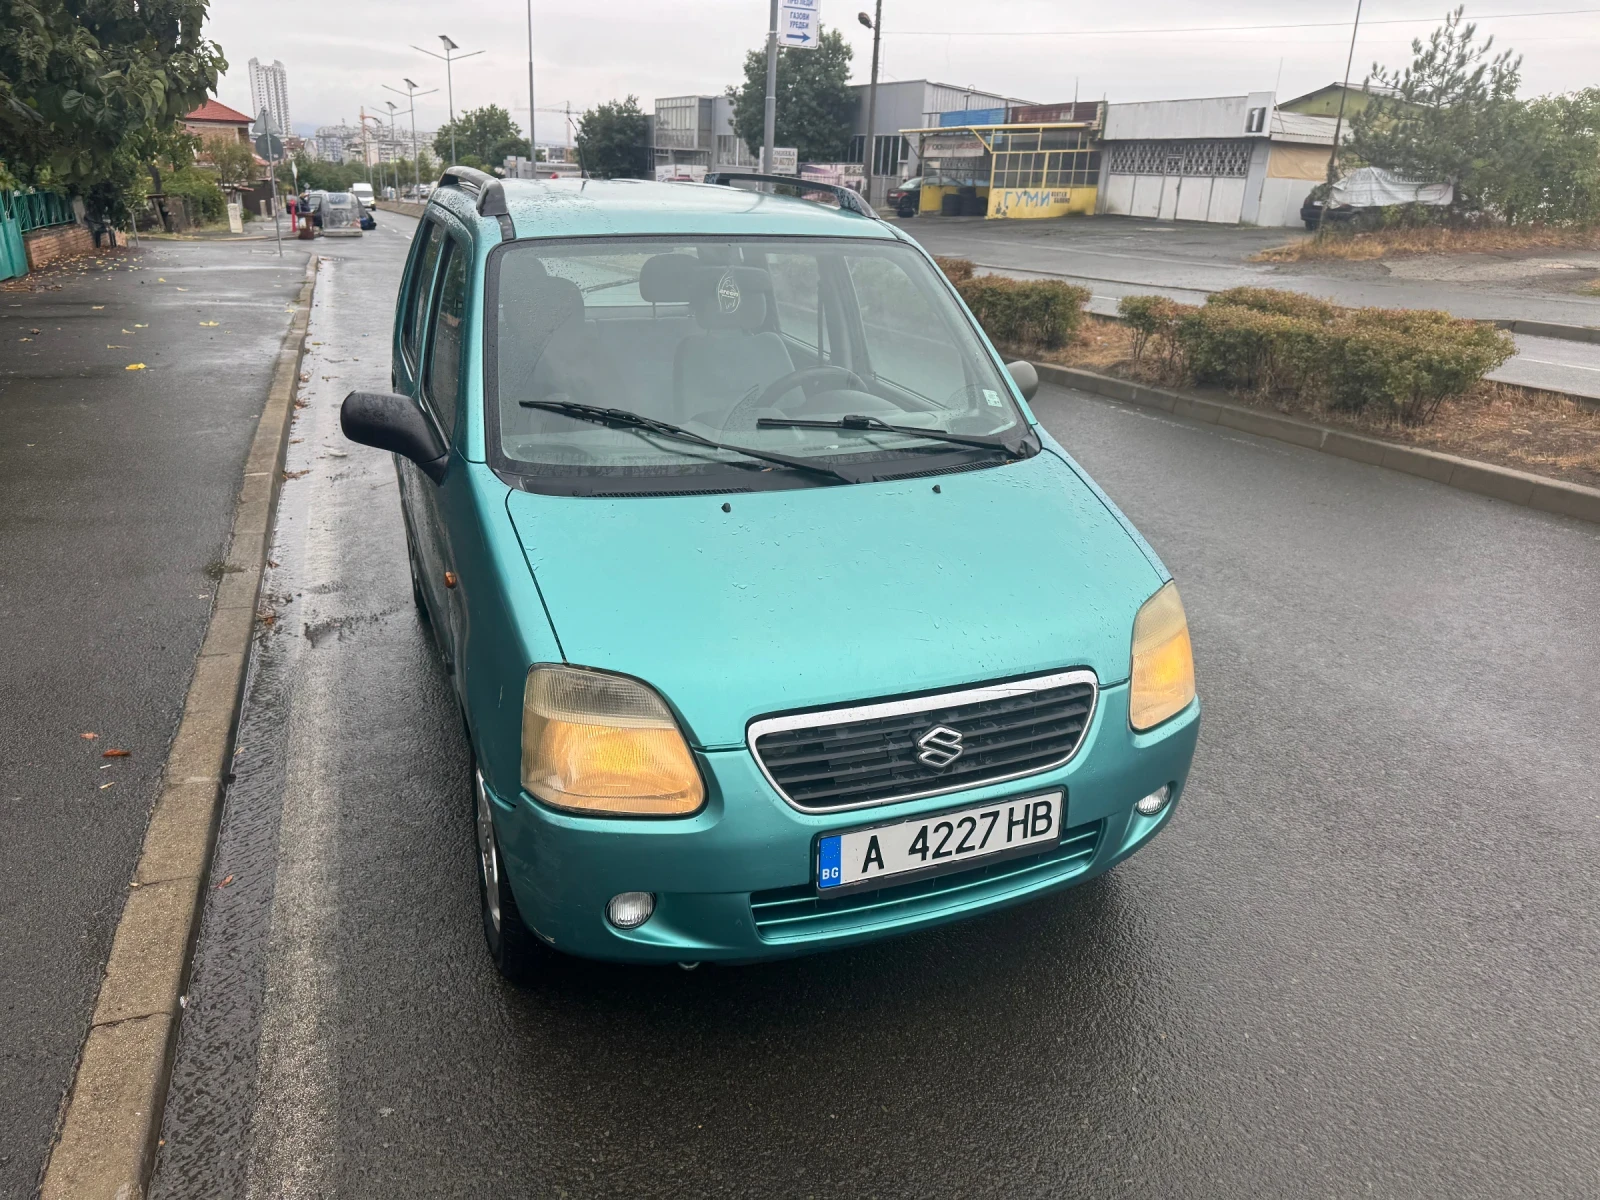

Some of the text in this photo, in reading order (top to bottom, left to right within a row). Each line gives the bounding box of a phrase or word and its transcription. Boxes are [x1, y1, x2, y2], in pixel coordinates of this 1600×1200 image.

[790, 12, 809, 20] ГАЗОВИ
[790, 20, 809, 29] УРЕДБИ
[1252, 110, 1259, 131] 1
[1004, 191, 1050, 207] ГУМИ
[822, 800, 1053, 880] BG A 4227 HB
